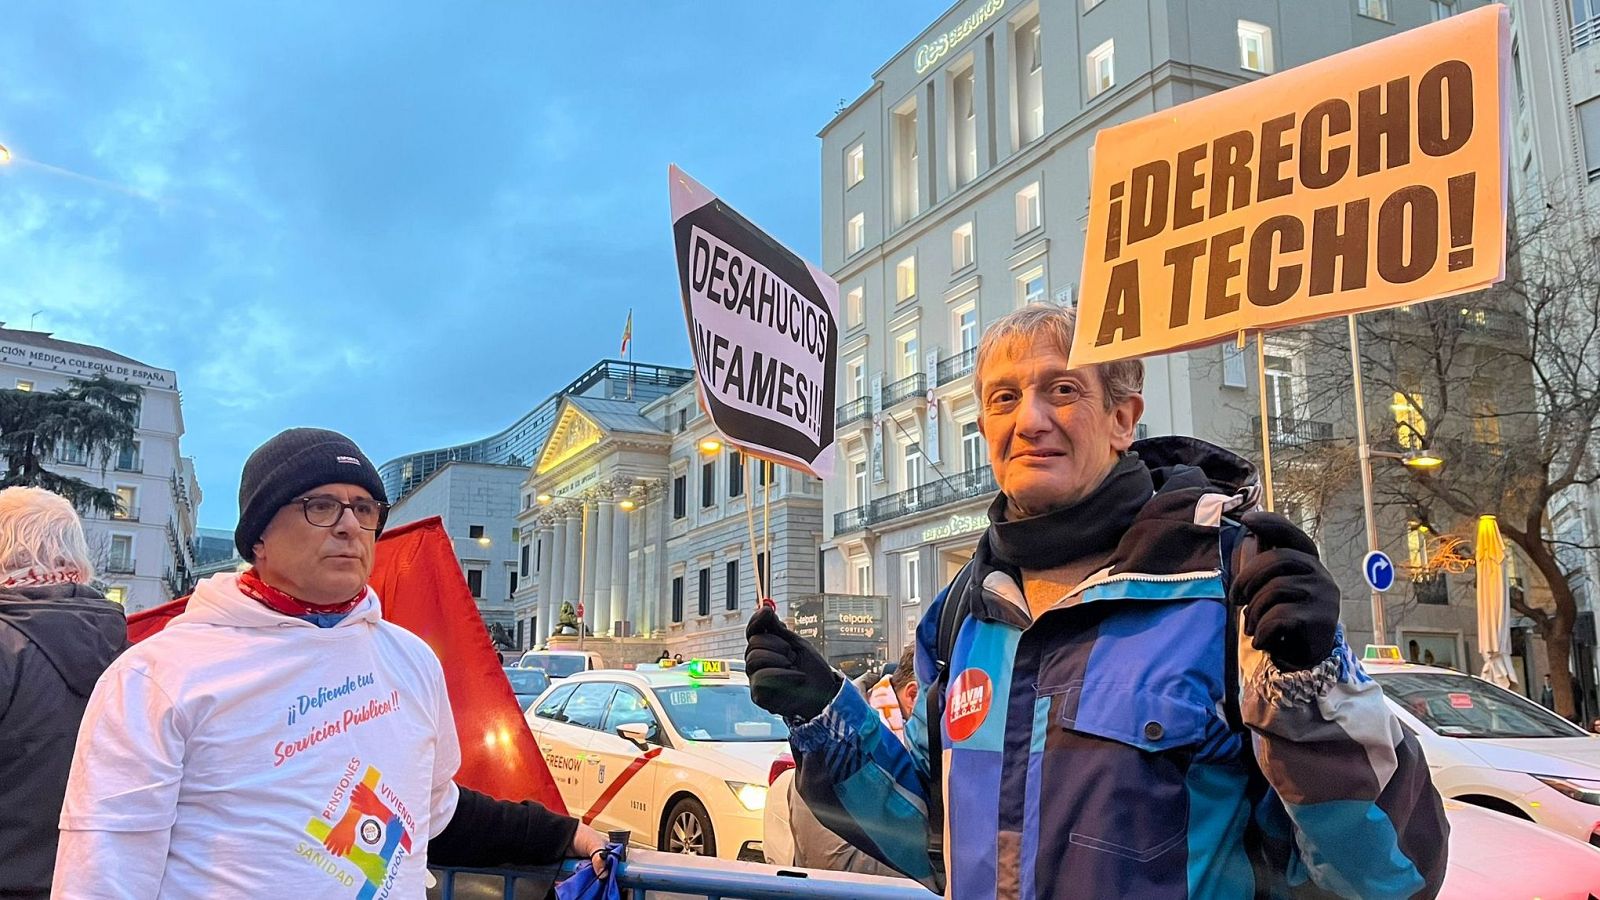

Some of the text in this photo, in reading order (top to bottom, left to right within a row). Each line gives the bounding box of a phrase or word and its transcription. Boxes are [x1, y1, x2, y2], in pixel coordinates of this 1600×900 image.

[1104, 59, 1474, 262] ¡DERECHO
[1095, 171, 1476, 347] A TECHO!
[692, 235, 826, 362] DESAHUCIOS
[0, 346, 26, 357] CIÓN
[68, 358, 114, 373] COLEGIAL
[117, 366, 129, 376] DE
[132, 369, 165, 382] ESPAÑA
[694, 317, 822, 437] INFAMES!!!
[358, 672, 375, 688] tus
[702, 660, 720, 673] TAXI
[274, 720, 341, 768] Servicios
[322, 757, 361, 820] PENSIONES
[381, 783, 416, 834] VIVIENDA
[295, 842, 354, 888] SANIDAD
